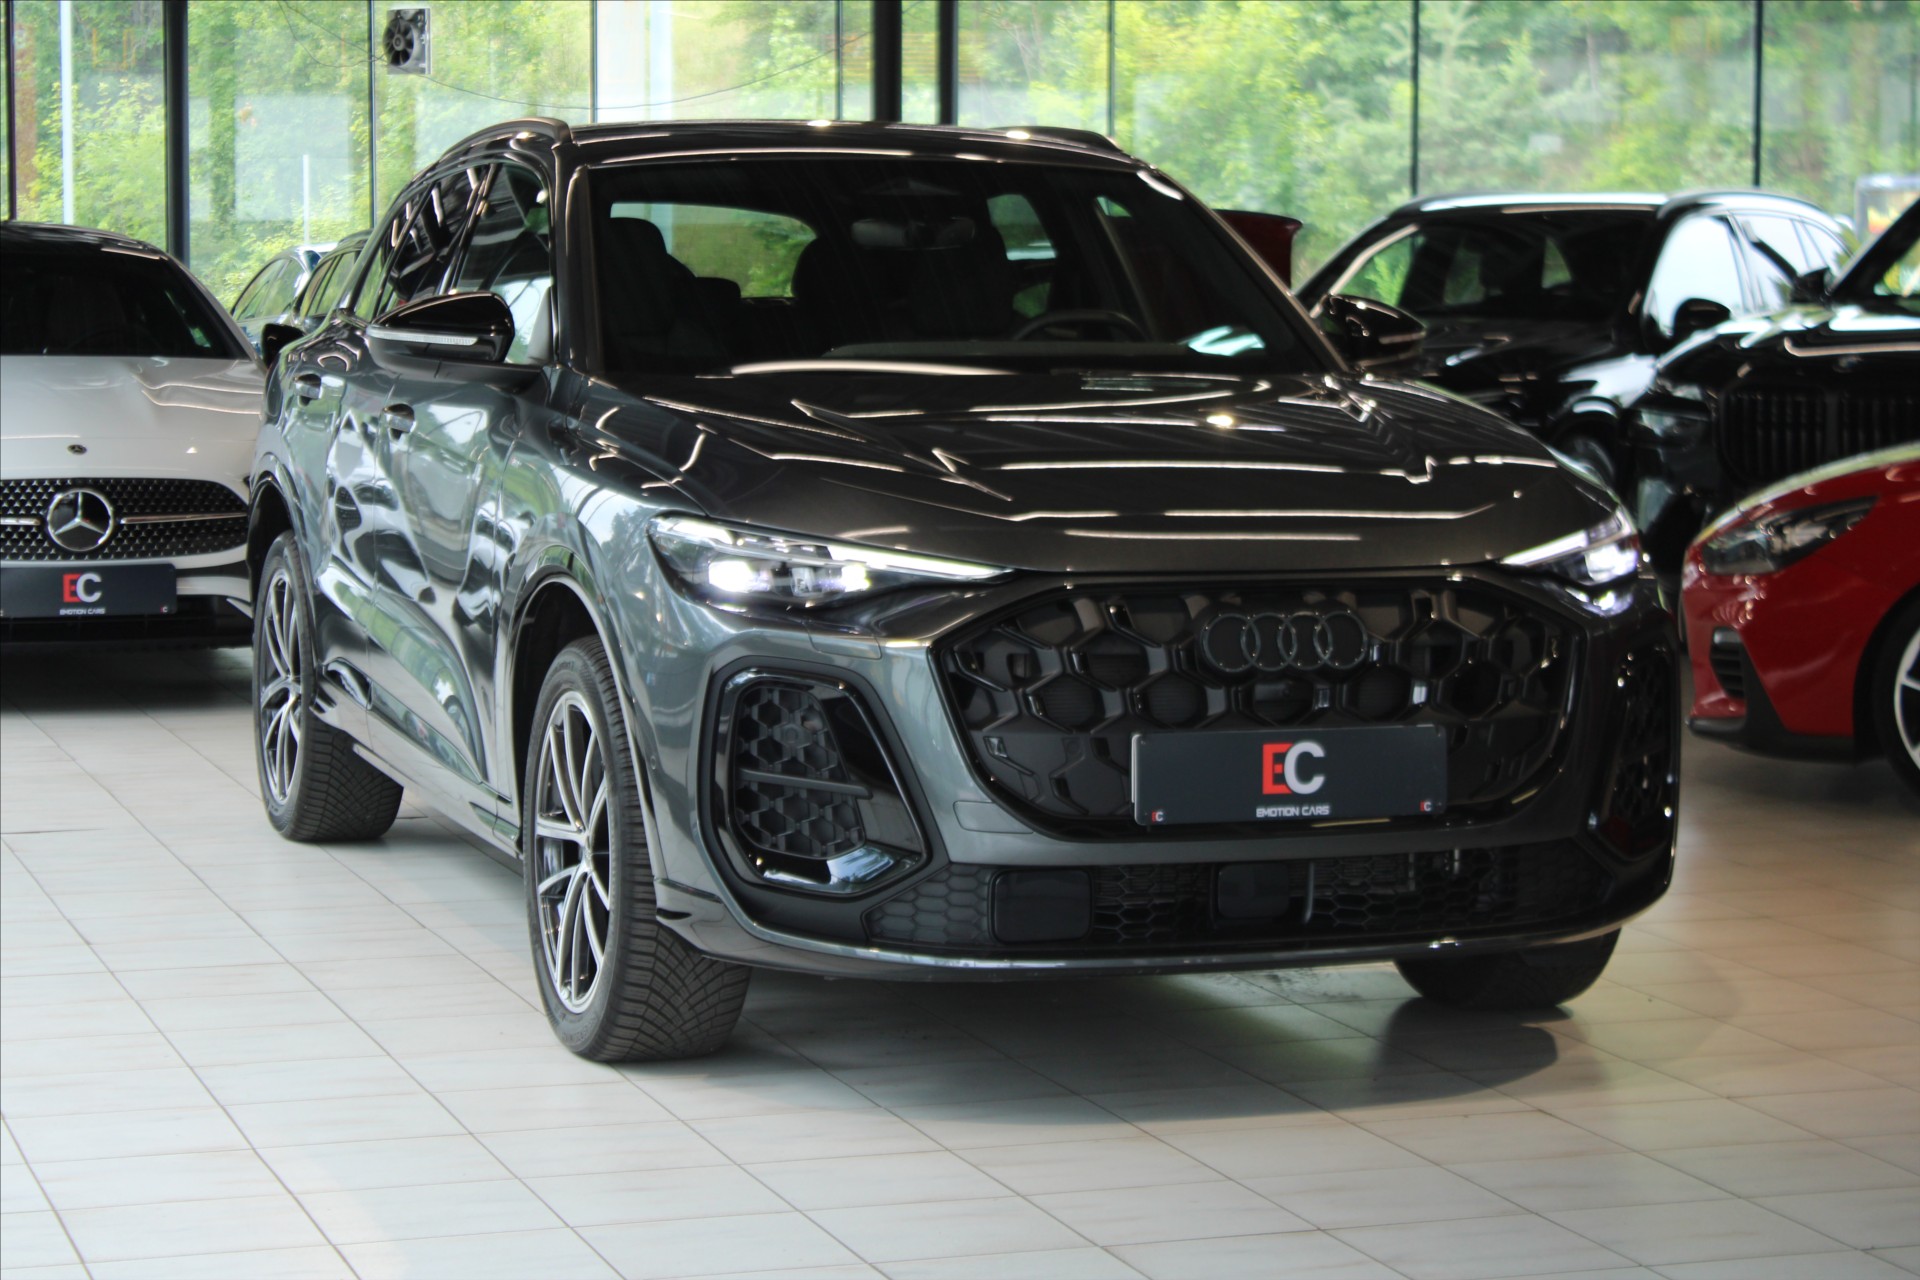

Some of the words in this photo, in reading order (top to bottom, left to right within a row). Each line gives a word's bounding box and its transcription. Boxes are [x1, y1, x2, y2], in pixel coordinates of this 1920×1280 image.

[63, 573, 102, 603] EC
[1262, 741, 1325, 795] EC
[1256, 807, 1300, 818] EMOTION
[1302, 805, 1330, 817] CARS
